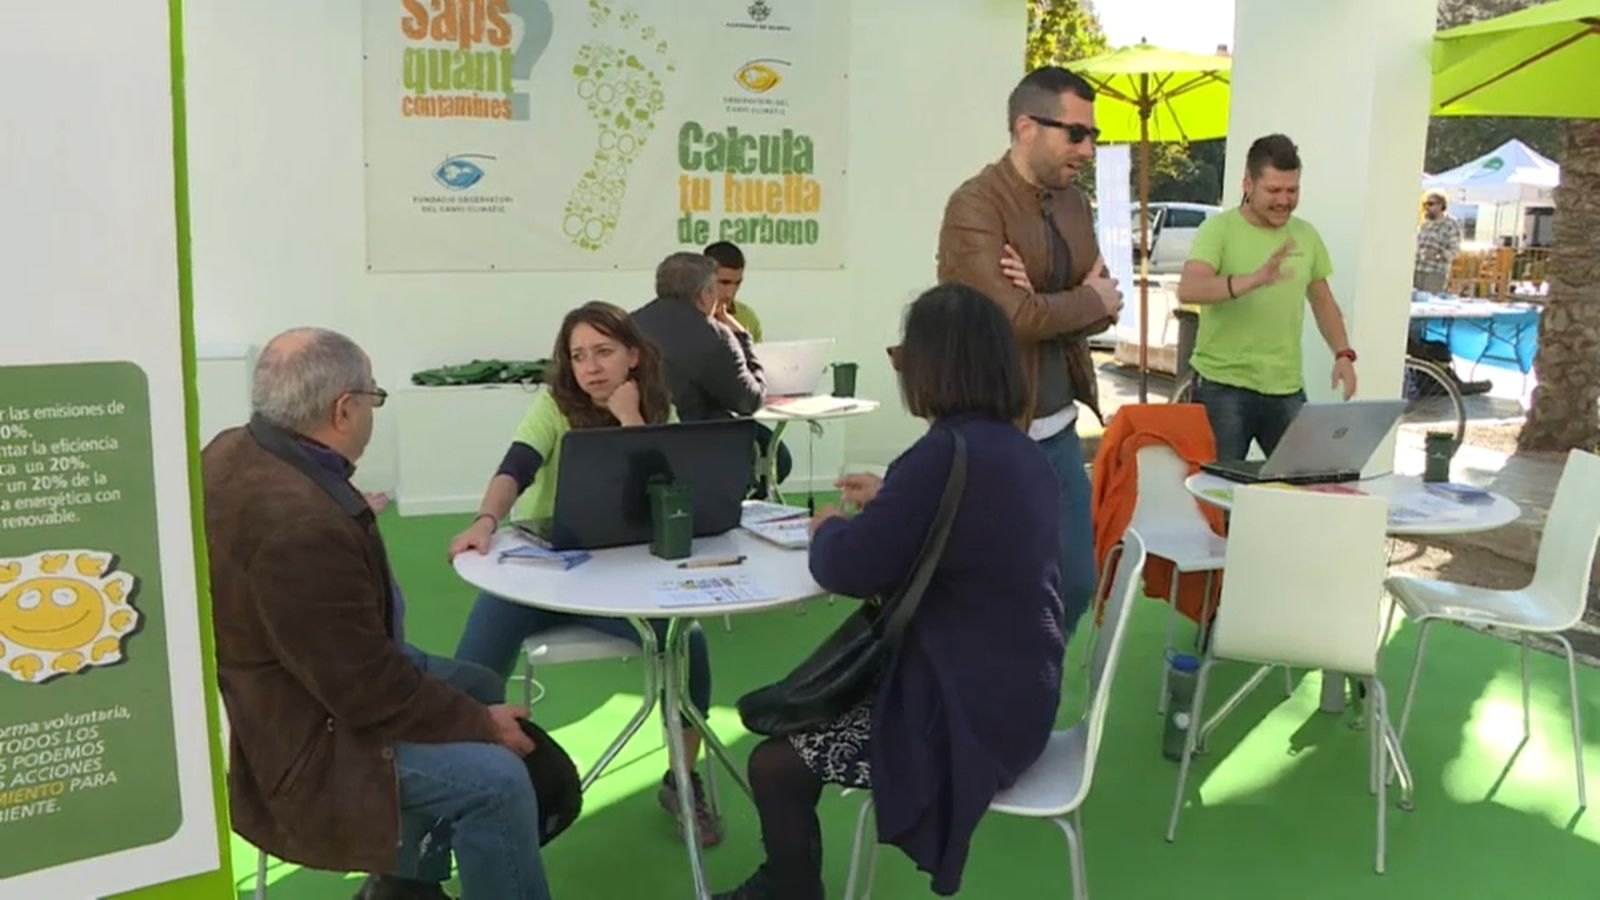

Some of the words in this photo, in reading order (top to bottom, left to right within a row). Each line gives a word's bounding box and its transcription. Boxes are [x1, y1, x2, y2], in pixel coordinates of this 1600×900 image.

[401, 0, 512, 50] Saps
[403, 47, 514, 95] quant
[402, 92, 513, 120] contamines
[679, 121, 814, 175] Calcula
[678, 174, 711, 214] tu
[724, 170, 821, 215] huella
[677, 211, 710, 246] de
[719, 214, 819, 246] carbono
[9, 405, 30, 421] las
[33, 402, 105, 420] emisiones
[107, 399, 125, 415] de
[32, 440, 47, 456] la
[50, 435, 119, 455] eficiencia
[25, 461, 44, 475] un
[49, 455, 90, 472] 20%.
[7, 480, 27, 493] un
[32, 474, 68, 491] 20%
[71, 472, 90, 488] de
[93, 470, 108, 486] la
[14, 490, 92, 514] energética
[95, 489, 121, 503] con
[2, 508, 80, 529] renovable.
[65, 725, 100, 745] LOS
[12, 739, 105, 771] PODEMOS
[9, 756, 103, 789] ACCIONES
[69, 771, 118, 793] PARA
